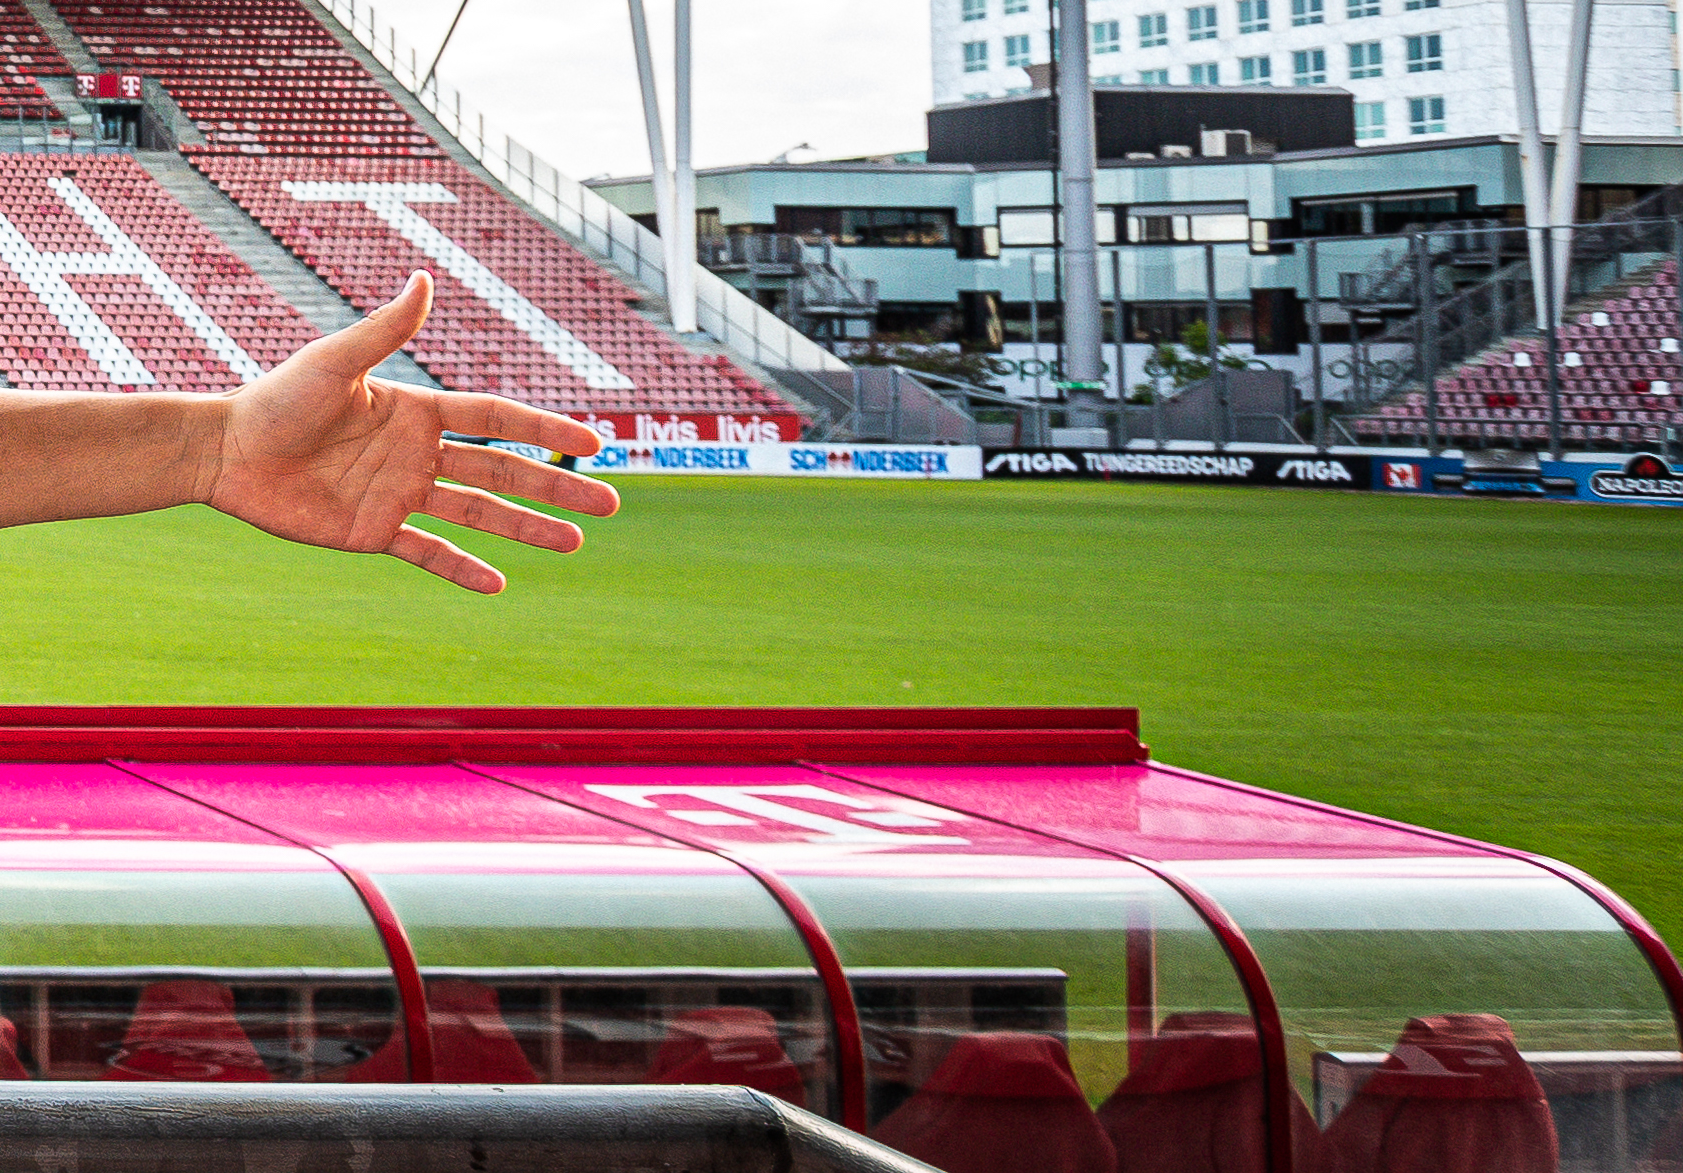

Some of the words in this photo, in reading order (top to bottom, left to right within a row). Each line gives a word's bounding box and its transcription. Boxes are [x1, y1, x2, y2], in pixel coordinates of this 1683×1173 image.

[76, 75, 95, 96] T
[121, 75, 141, 97] T
[635, 414, 699, 442] livis
[717, 415, 781, 443] livis
[985, 453, 1078, 473] STIGA
[1276, 459, 1352, 481] STIGA
